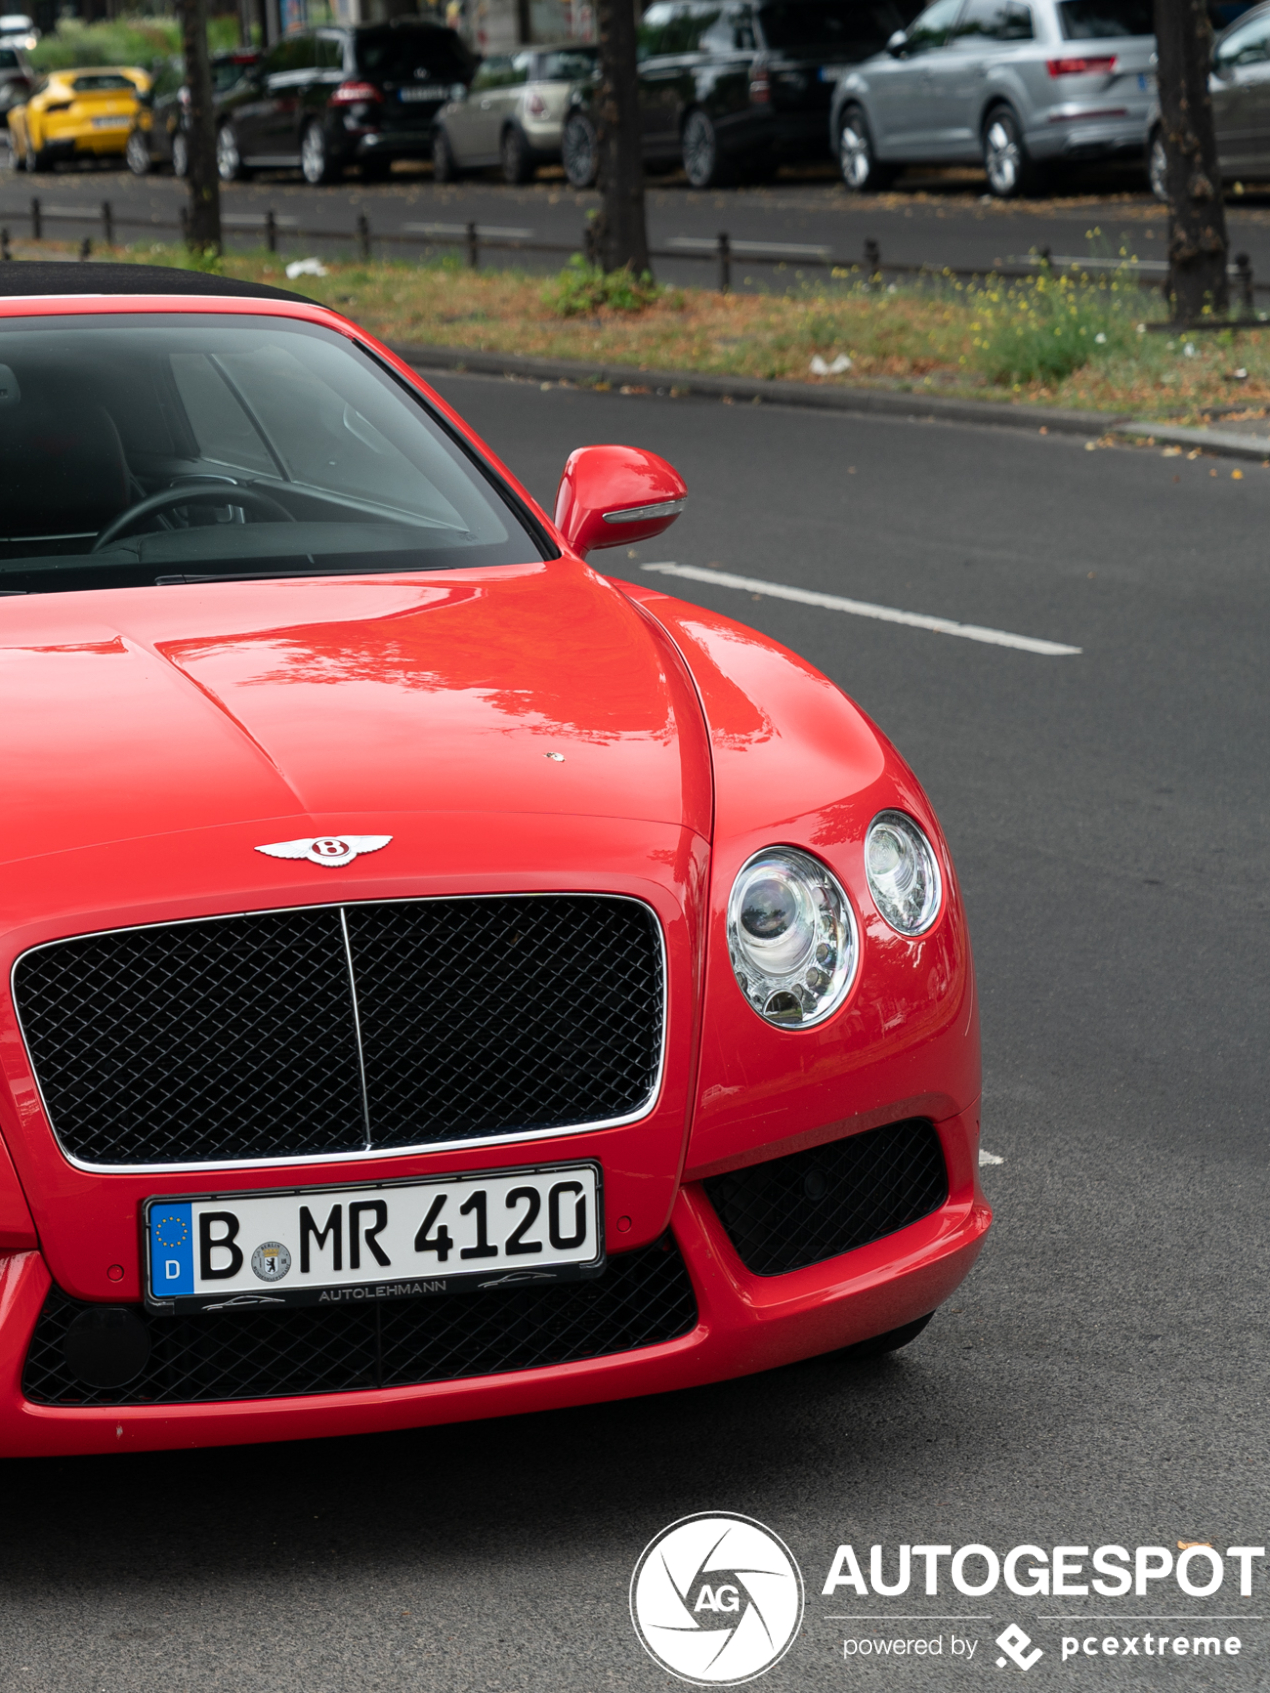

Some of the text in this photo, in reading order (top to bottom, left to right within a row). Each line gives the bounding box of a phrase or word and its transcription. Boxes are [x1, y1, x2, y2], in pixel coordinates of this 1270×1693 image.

[316, 840, 345, 855] B
[199, 1180, 586, 1280] B MR 4120
[165, 1260, 180, 1279] D
[319, 1280, 447, 1302] AUTOLEHMANN
